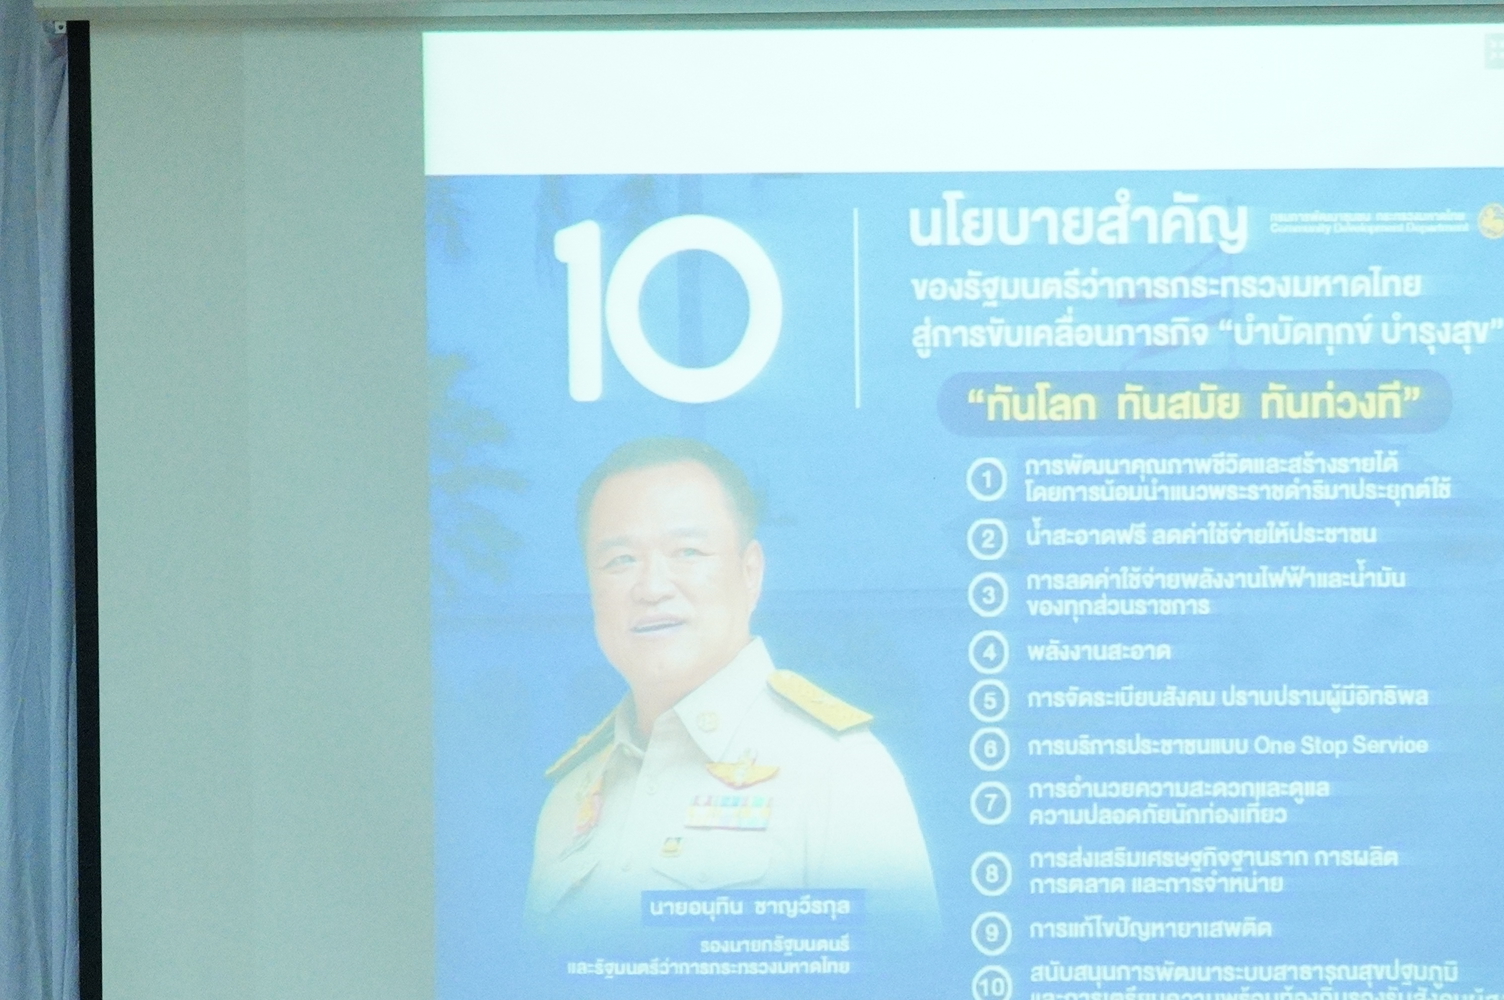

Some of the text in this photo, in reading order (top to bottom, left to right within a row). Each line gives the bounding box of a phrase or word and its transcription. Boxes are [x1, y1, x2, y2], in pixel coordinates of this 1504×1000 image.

[910, 189, 1249, 254] นโยบายสำคัญ
[910, 265, 1423, 308] ของรัฐมนตรีว่าการกระทรวงมหาดไทย
[555, 214, 783, 404] 10
[911, 306, 1211, 358] สู่การขับเคลื่อนภารกิจ
[1118, 383, 1241, 420] ทันสมัย
[1024, 450, 1400, 479] การพัฒนาคุณภาพชีวิตและสร้างรายได้
[982, 472, 994, 489] 1
[981, 529, 995, 548] 2
[1027, 518, 1377, 545] น้ำสะอาดฟรี ลดค่าใช้จ่ายให้ประชาชน
[982, 586, 996, 605] 3
[1027, 596, 1211, 622] ของทุกส่วนราชการ
[982, 644, 997, 661] 4
[1028, 640, 1172, 660] พลังงานสะอาด
[984, 691, 997, 708] 5
[1028, 684, 1429, 713] การจัดระเบียบสังคม ปราบปรามผู้มีอิทธิพล
[984, 740, 998, 758] 6
[1029, 734, 1429, 758] การบริการประชาชนแบบ One Stop Service
[1029, 776, 1331, 805] การอำนวยความสะดวกและดูแล
[984, 795, 998, 813] 7
[1314, 846, 1399, 866] การผลิต
[985, 864, 999, 883] 8
[1030, 872, 1284, 895] การตลาด และการจำหน่าย
[650, 894, 851, 922] นายอนุทิน ชาญวีรกุล
[985, 923, 999, 943] 9
[1030, 915, 1273, 941] การแก้ไขปัญหายาเสพติด
[979, 977, 1004, 998] 10
